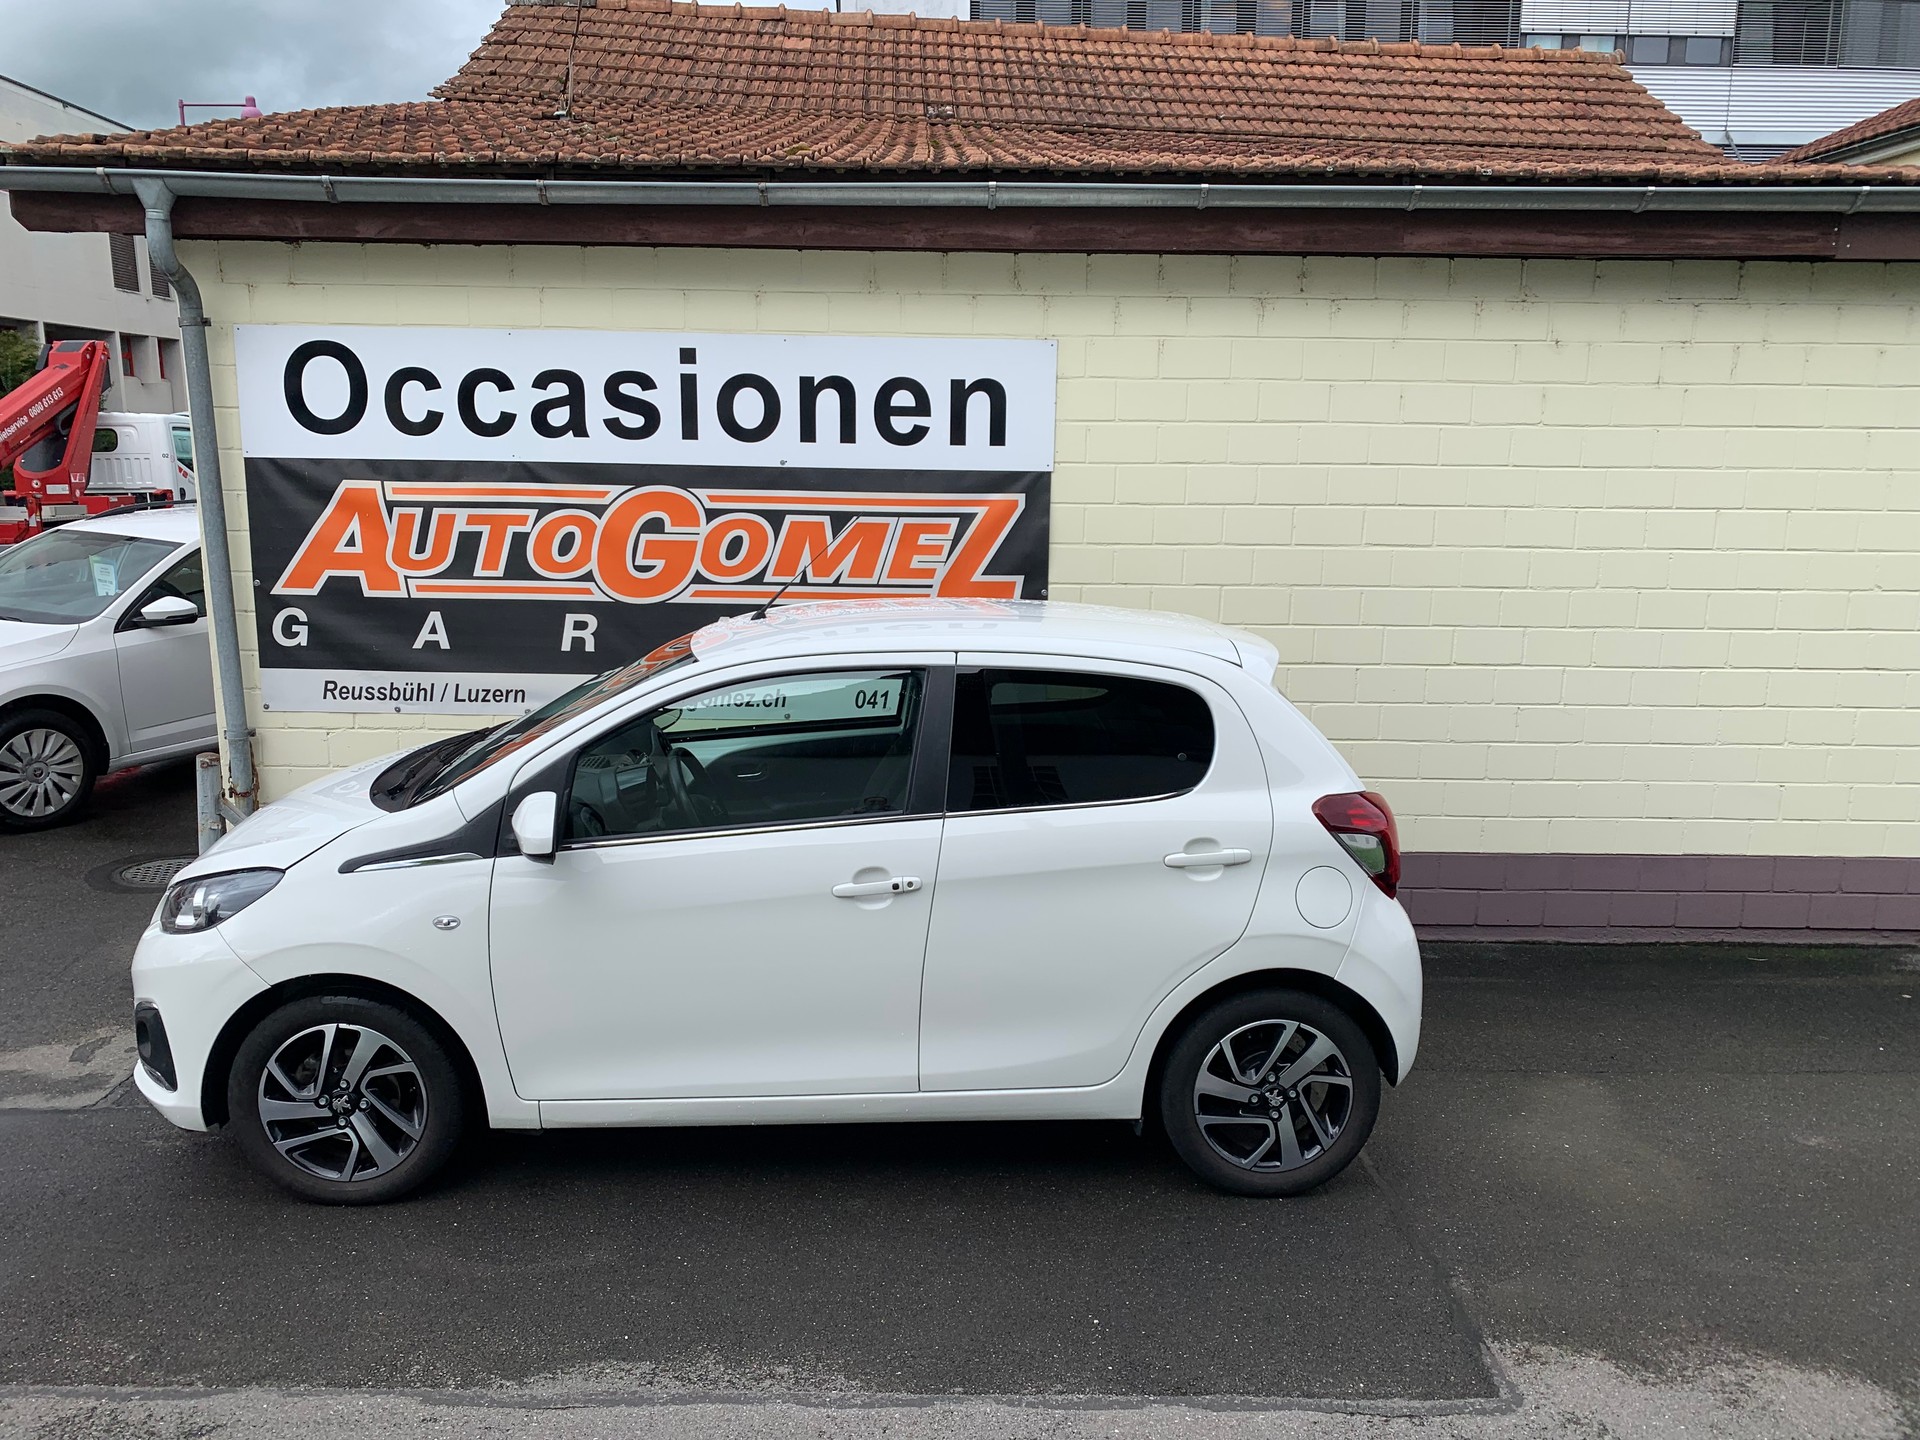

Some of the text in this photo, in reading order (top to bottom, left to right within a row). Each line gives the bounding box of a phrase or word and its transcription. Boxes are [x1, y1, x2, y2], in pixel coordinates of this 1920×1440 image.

[284, 340, 1007, 446] Occasionen
[0, 386, 64, 441] ietservice 0800 813 813
[322, 680, 435, 704] Reussbühl
[454, 687, 526, 705] Luzern
[854, 689, 890, 710] 041
